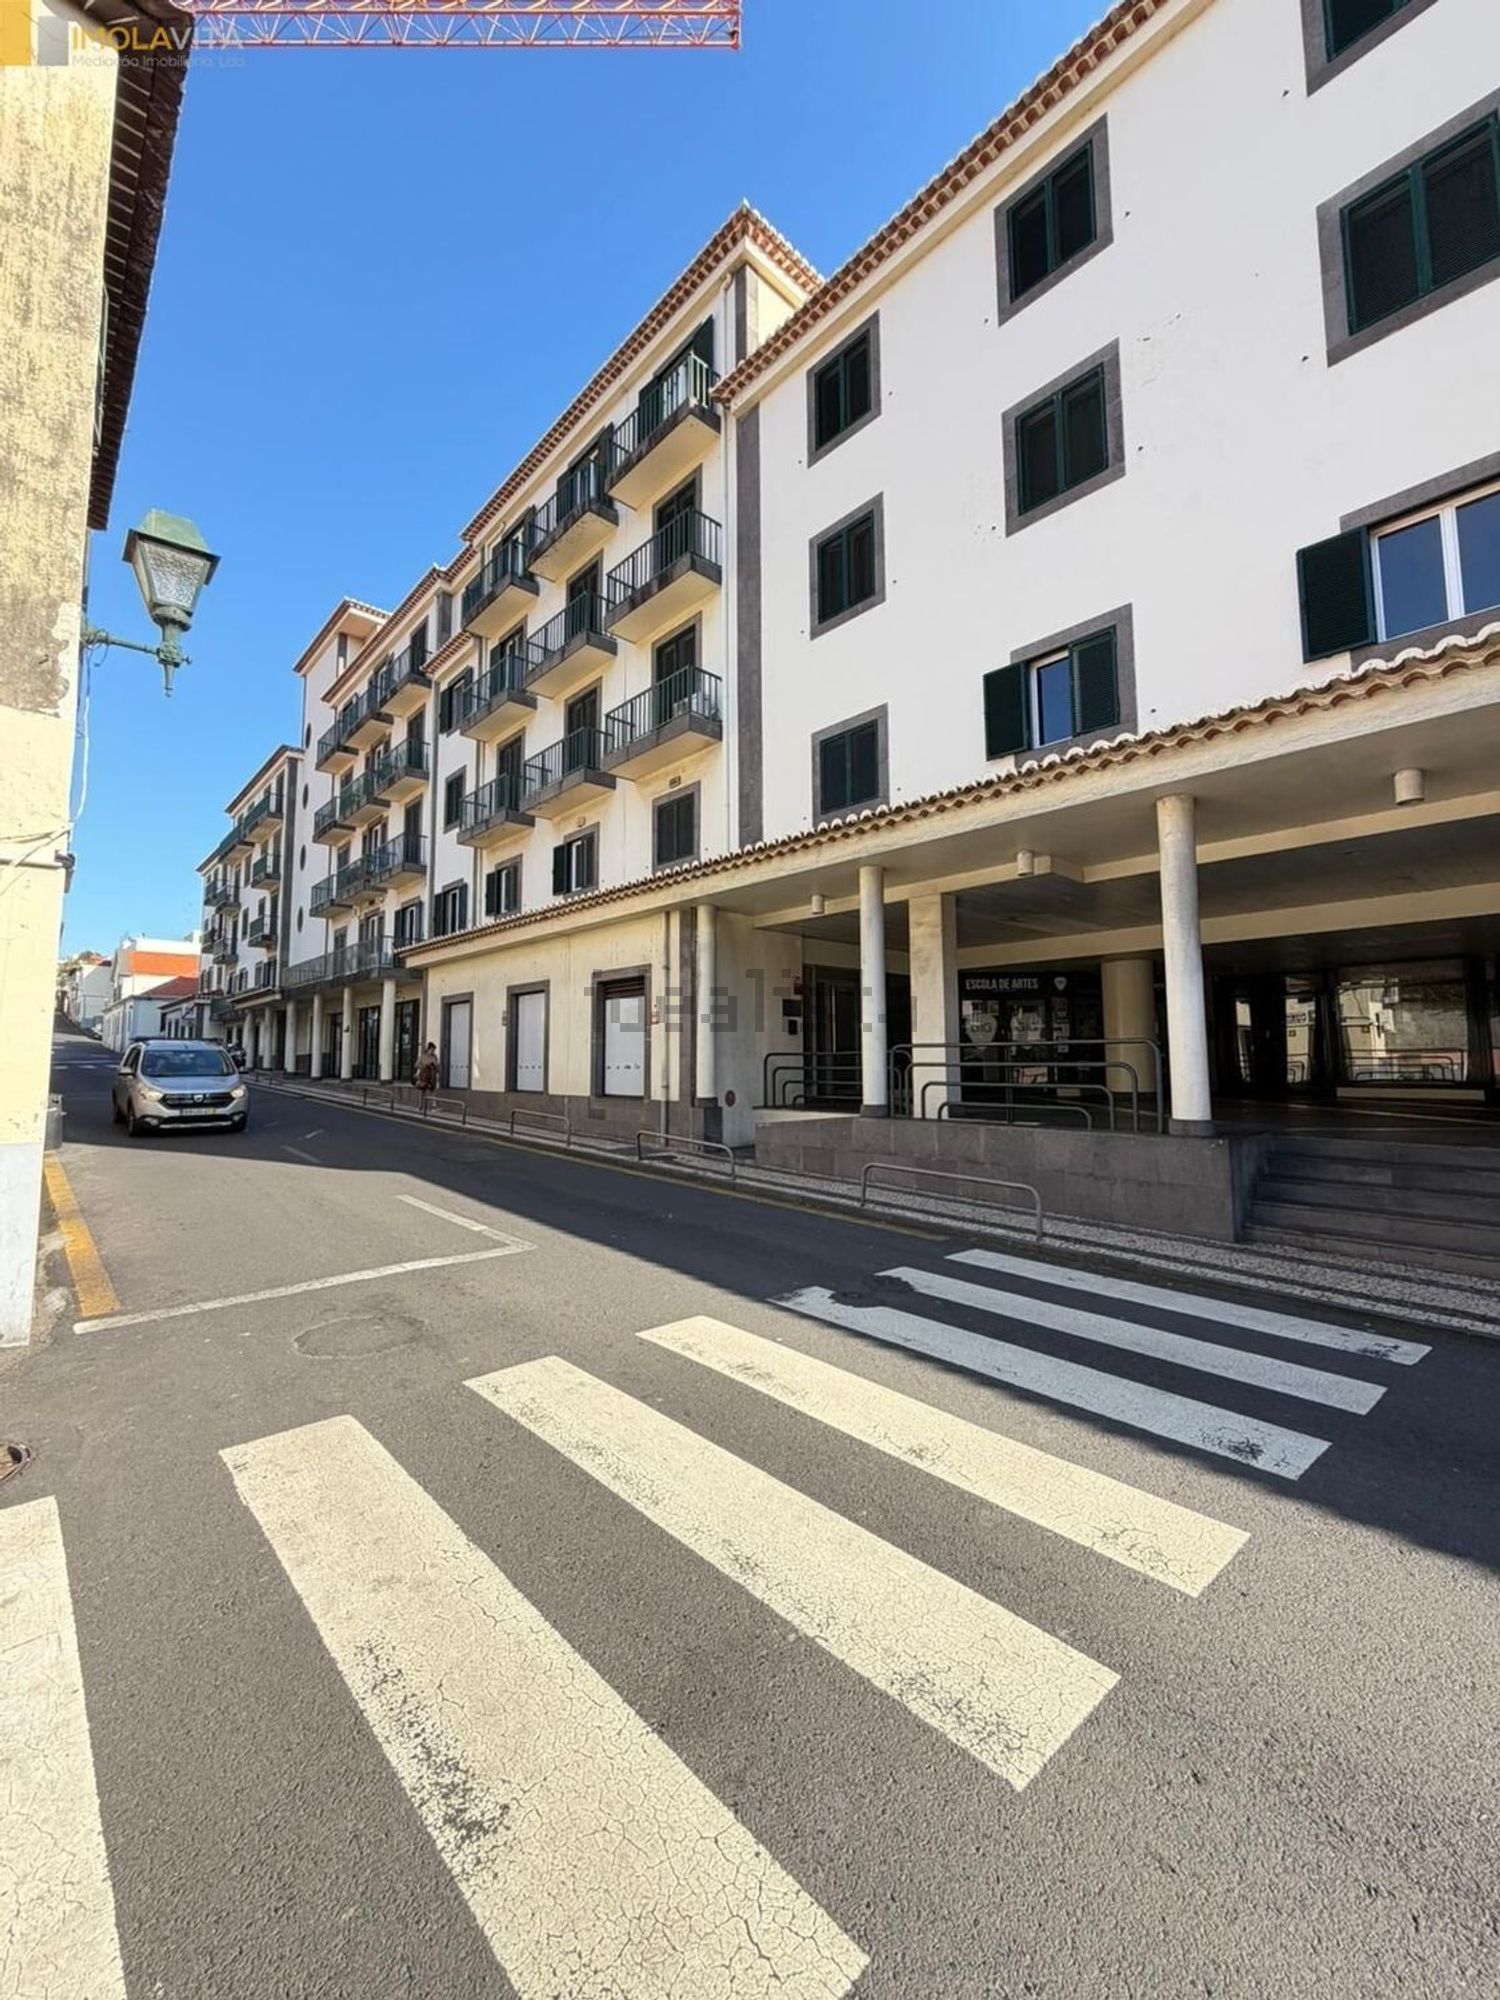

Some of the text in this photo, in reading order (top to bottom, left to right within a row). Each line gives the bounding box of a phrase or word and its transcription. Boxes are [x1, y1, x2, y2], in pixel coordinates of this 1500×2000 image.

[965, 977, 1039, 990] ESCOLA DE ARTES
